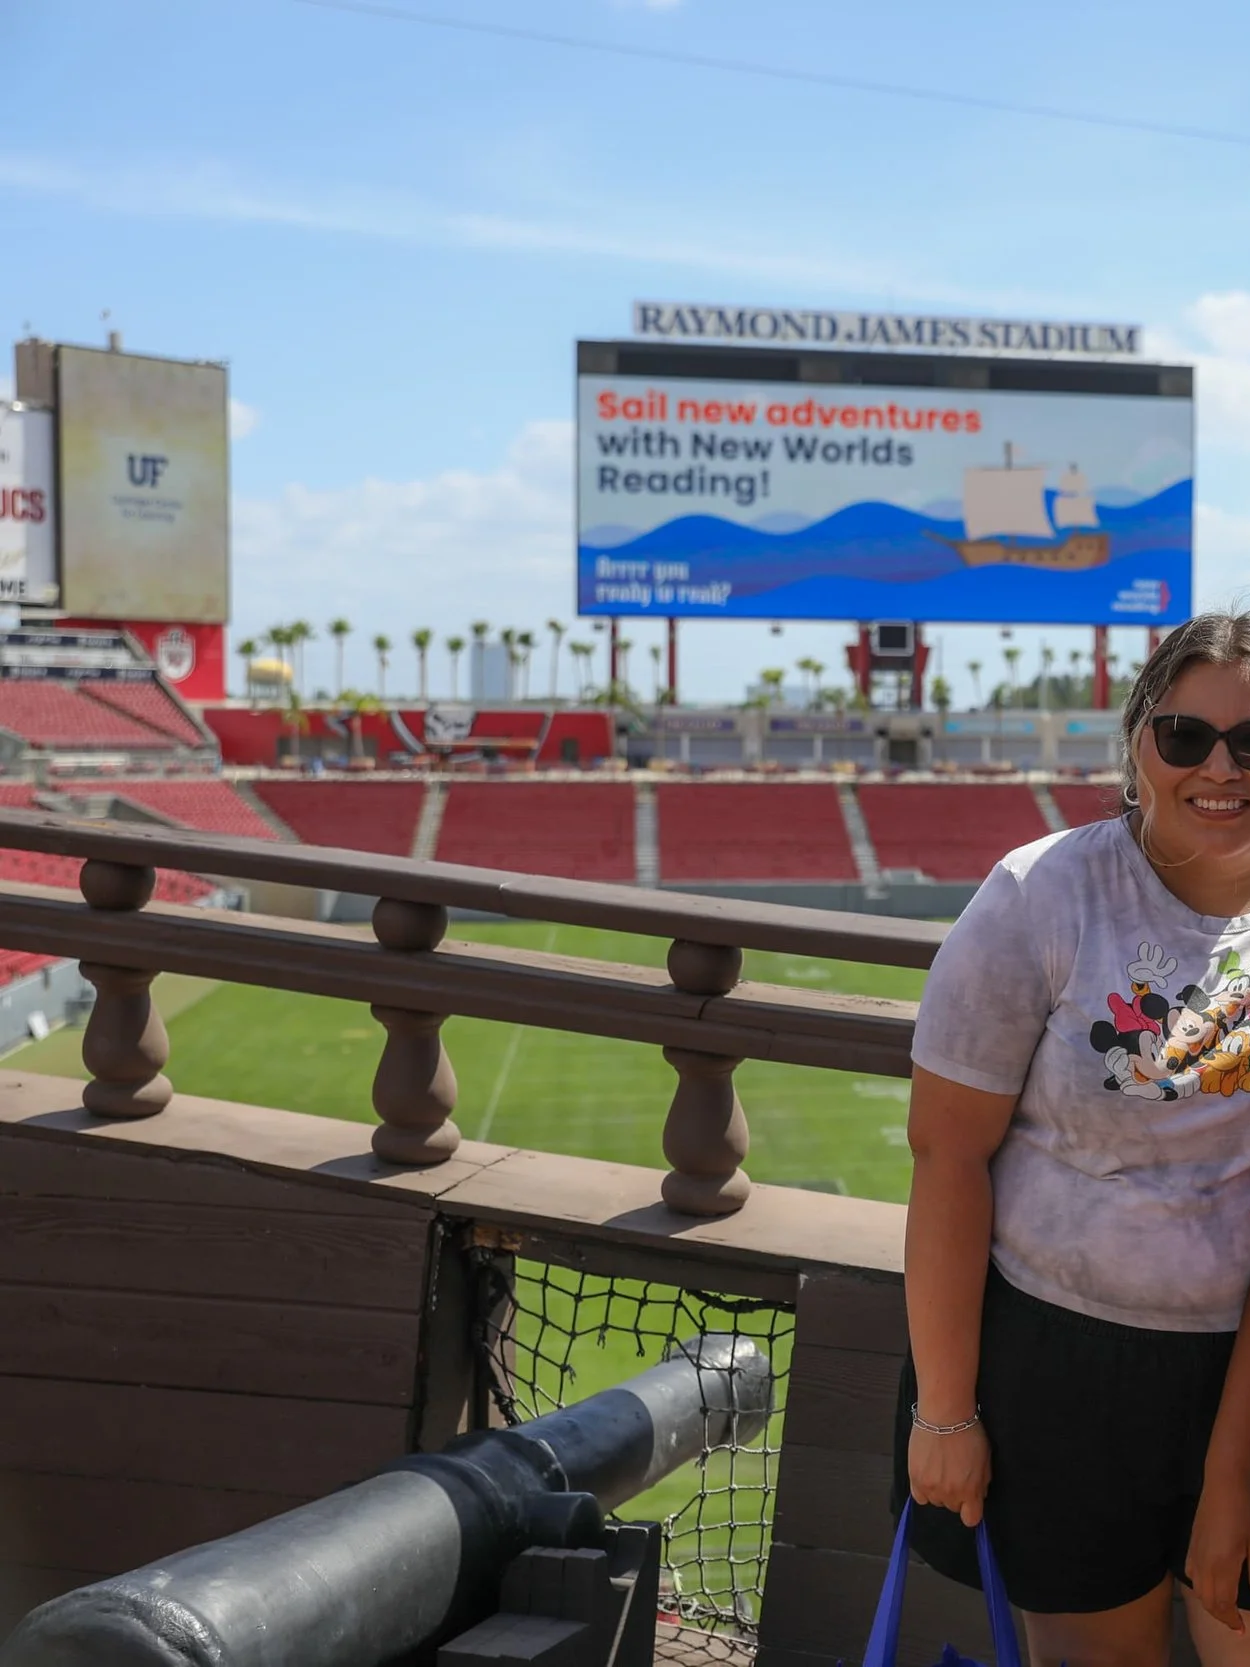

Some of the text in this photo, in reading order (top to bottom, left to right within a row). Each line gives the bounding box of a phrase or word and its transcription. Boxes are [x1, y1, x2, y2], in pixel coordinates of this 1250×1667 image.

[637, 305, 1139, 352] RAYMOND JAMES STADIUM
[597, 388, 981, 433] Sail new adventures
[598, 428, 914, 466] with New Worlds
[127, 453, 168, 488] UF
[598, 465, 771, 505] Reading!
